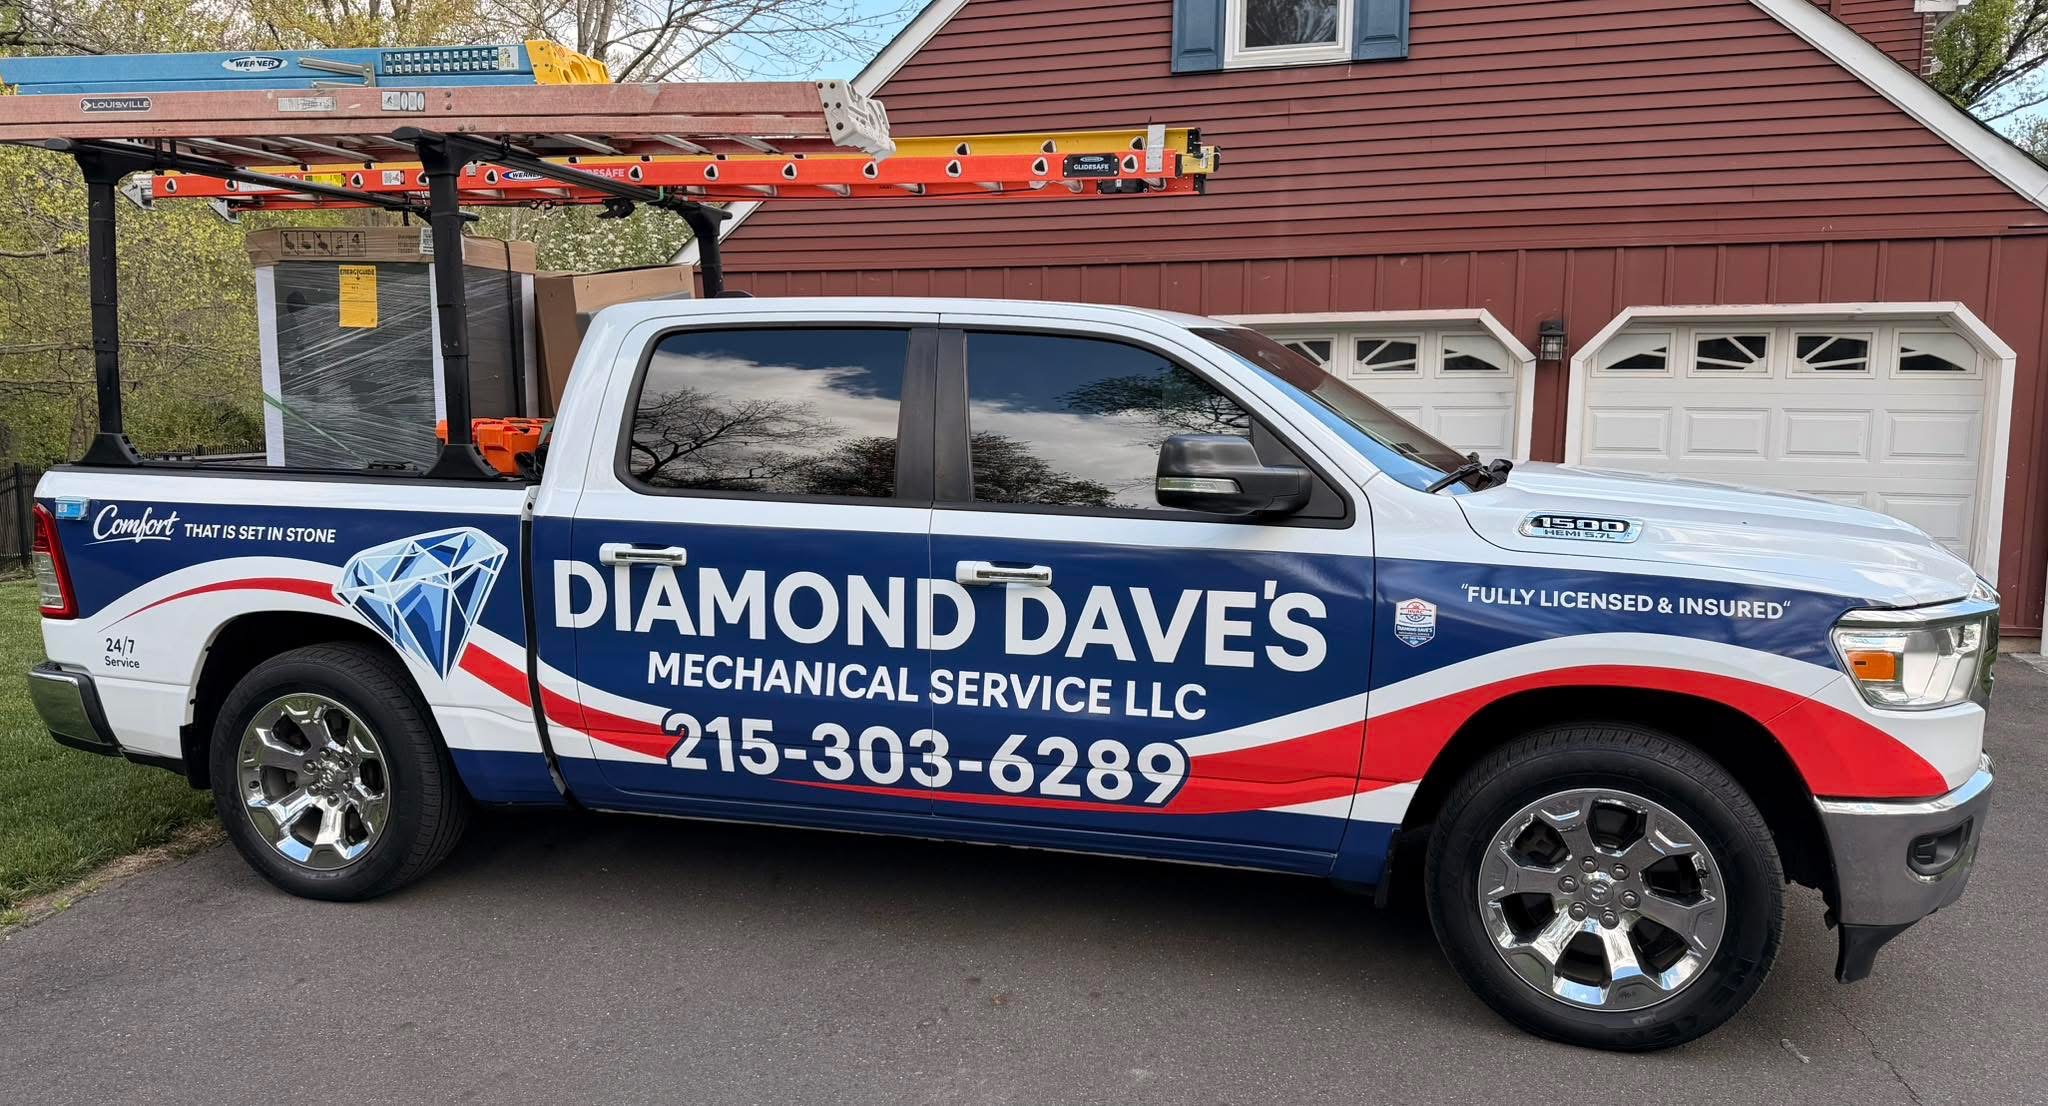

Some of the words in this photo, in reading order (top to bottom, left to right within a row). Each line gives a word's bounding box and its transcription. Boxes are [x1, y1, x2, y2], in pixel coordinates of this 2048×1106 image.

[92, 100, 150, 109] LOUISVILLE
[93, 504, 180, 543] Comfort
[184, 523, 221, 539] THAT
[222, 525, 236, 539] IS
[238, 526, 266, 540] SET
[267, 526, 283, 541] IN
[286, 528, 337, 543] STONE
[1542, 517, 1625, 532] 1500
[1584, 531, 1616, 539] 5.7L
[1540, 590, 1654, 612] LICENSED
[1657, 597, 1674, 613] &
[553, 559, 976, 651] DIAMOND
[1004, 580, 1328, 673] DAVE'S
[106, 636, 135, 656] 24/7
[105, 656, 140, 668] Service
[647, 650, 919, 703] MECHANICAL
[928, 668, 1112, 715] SERVICE
[1125, 680, 1208, 721] LLC
[665, 712, 1186, 804] 215-303-6289
